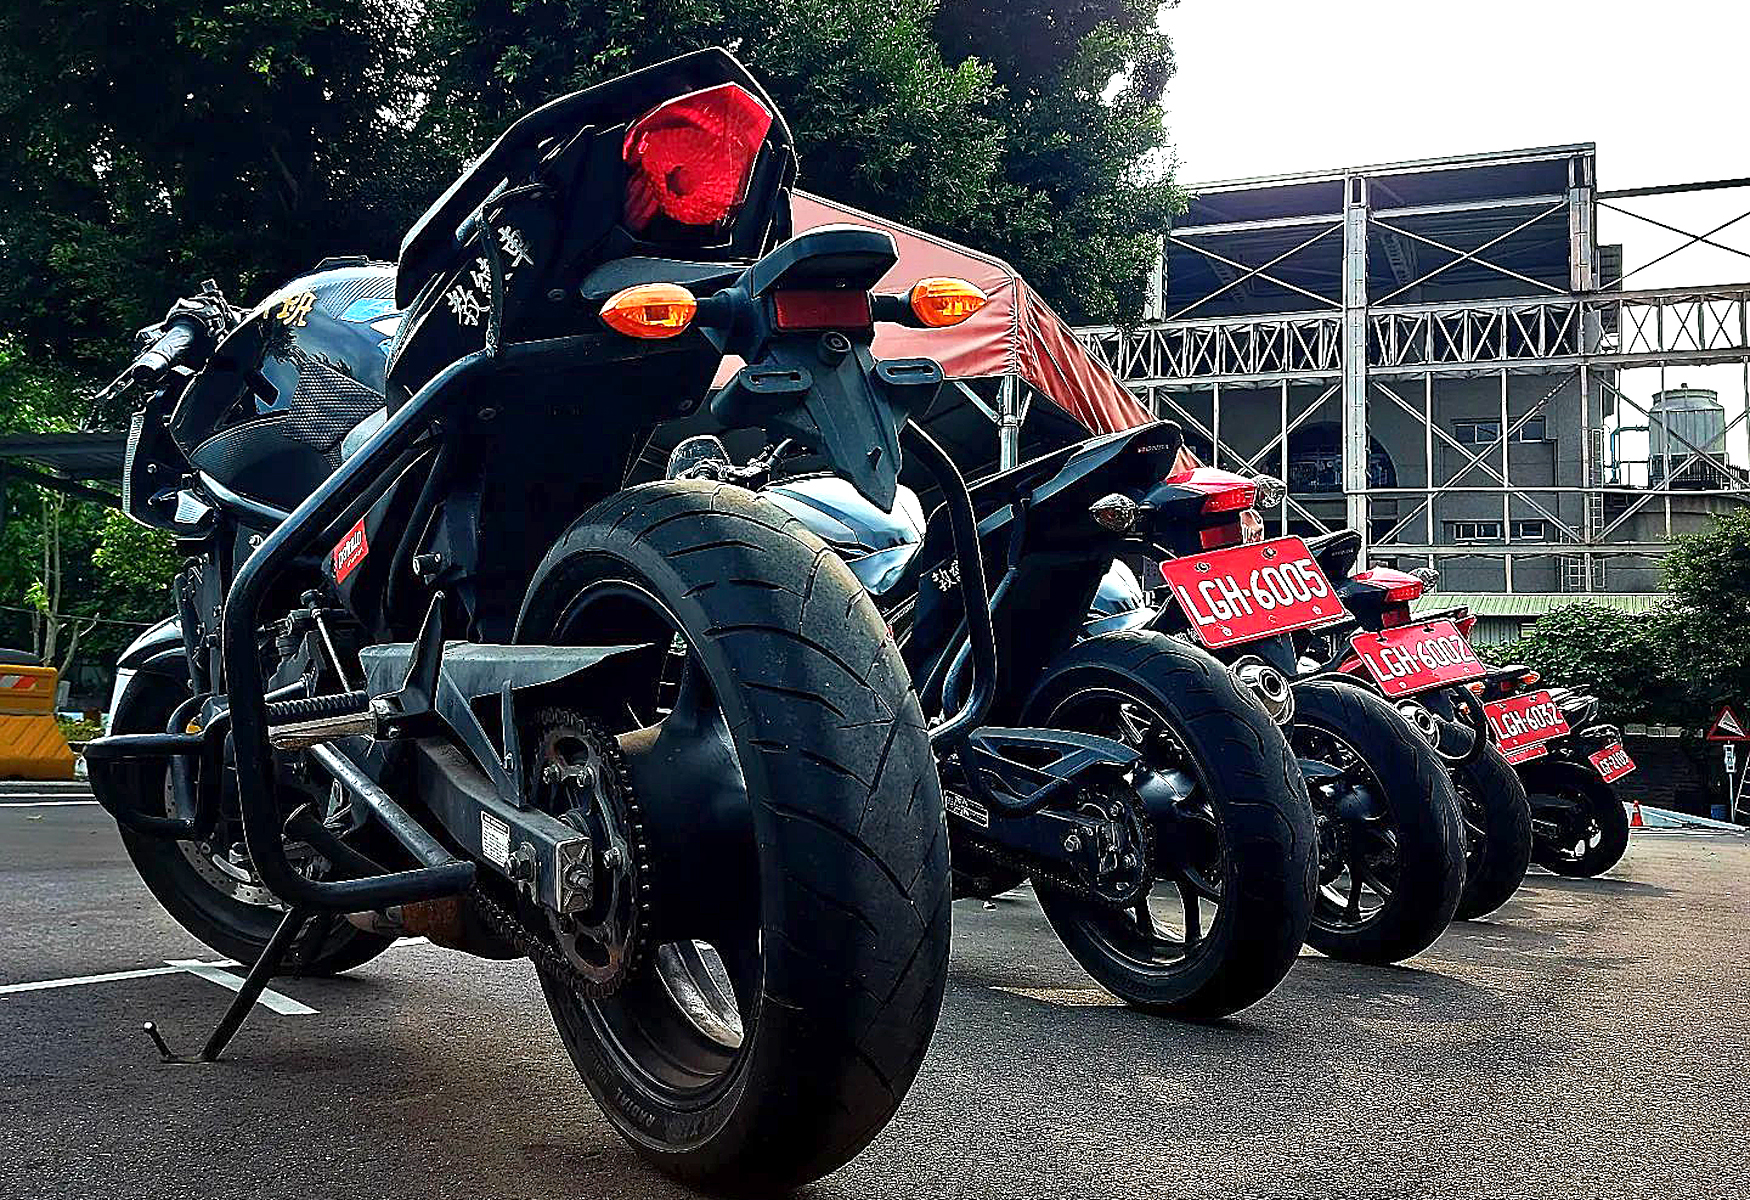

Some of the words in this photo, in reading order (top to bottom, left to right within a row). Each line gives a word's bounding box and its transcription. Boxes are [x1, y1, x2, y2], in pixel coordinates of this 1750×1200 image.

[1177, 558, 1329, 626] LGH-6005
[1363, 635, 1476, 682] LGH-6002
[1490, 702, 1564, 740] LGH-6032
